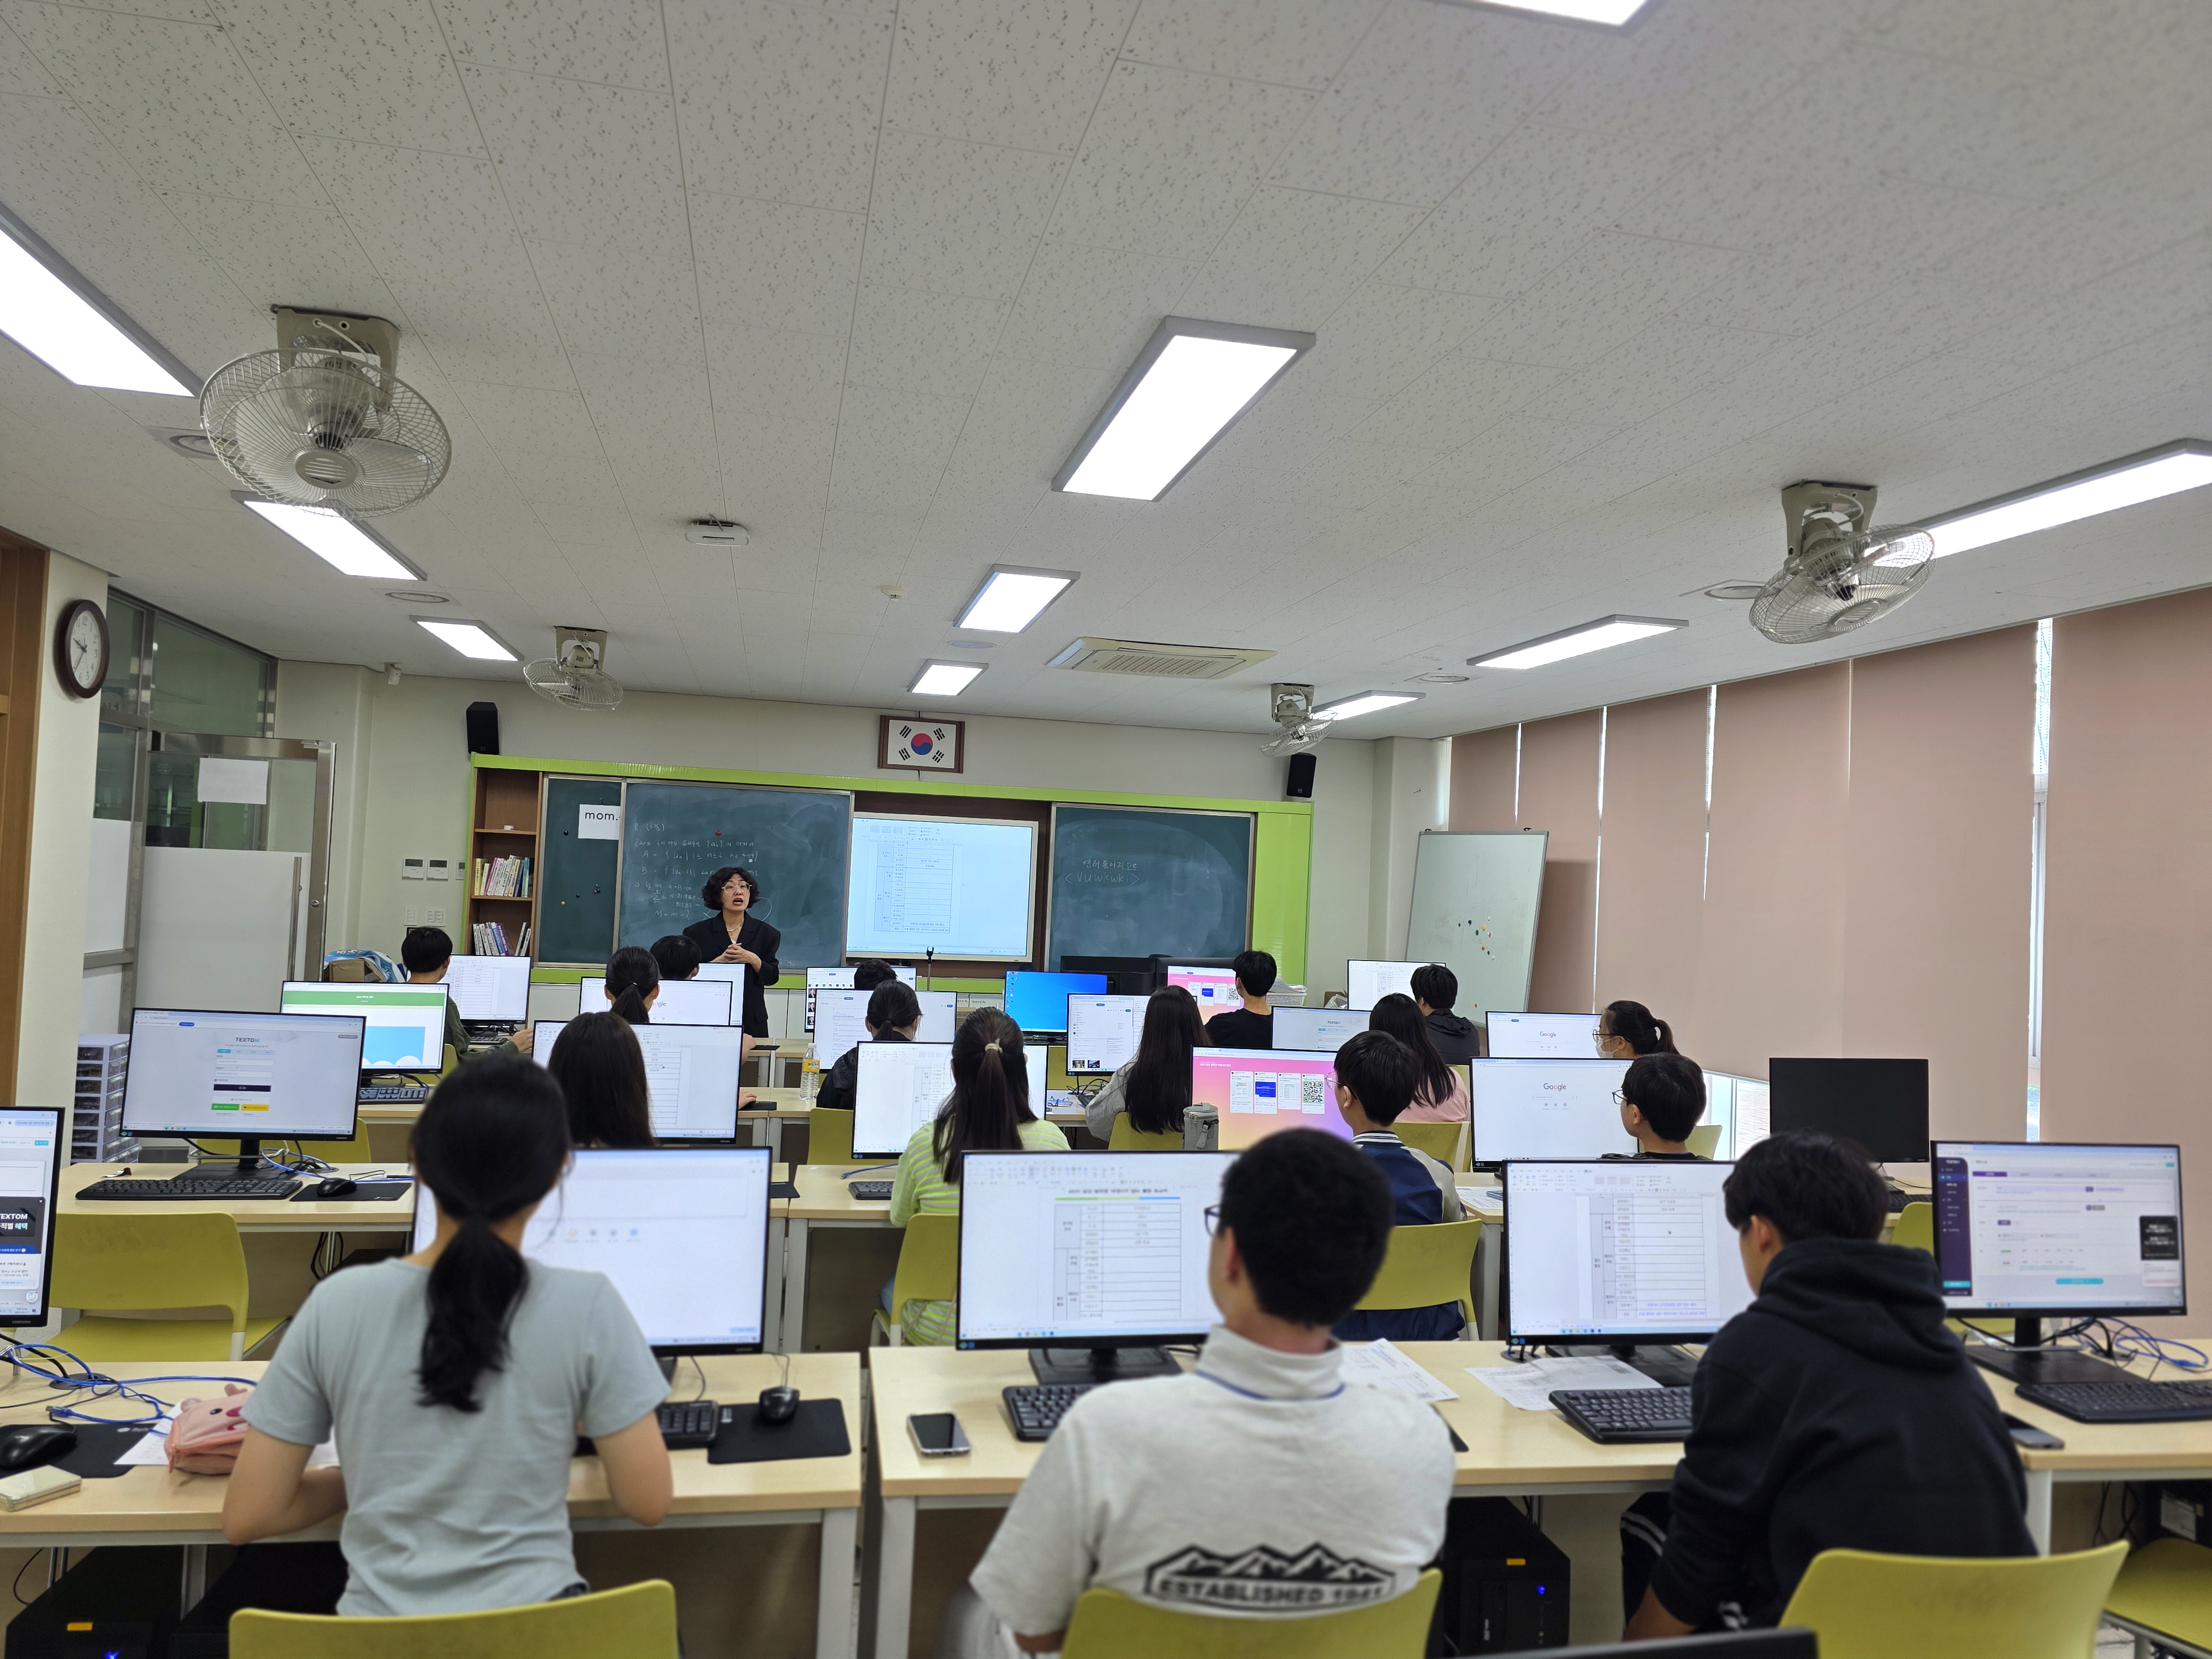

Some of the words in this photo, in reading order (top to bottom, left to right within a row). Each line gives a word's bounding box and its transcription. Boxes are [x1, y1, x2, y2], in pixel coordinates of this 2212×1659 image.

[82, 615, 88, 626] 12
[90, 622, 93, 632] 1
[93, 634, 98, 644] 2
[93, 649, 98, 659] 3
[90, 662, 95, 671] 4
[79, 672, 82, 682] 6
[585, 812, 620, 821] mom.
[641, 850, 649, 859] A
[641, 866, 648, 875] B
[1543, 1083, 1567, 1092] Google
[15, 1222, 28, 1230] 혜택
[1159, 1577, 1324, 1603] ESTABLISHED
